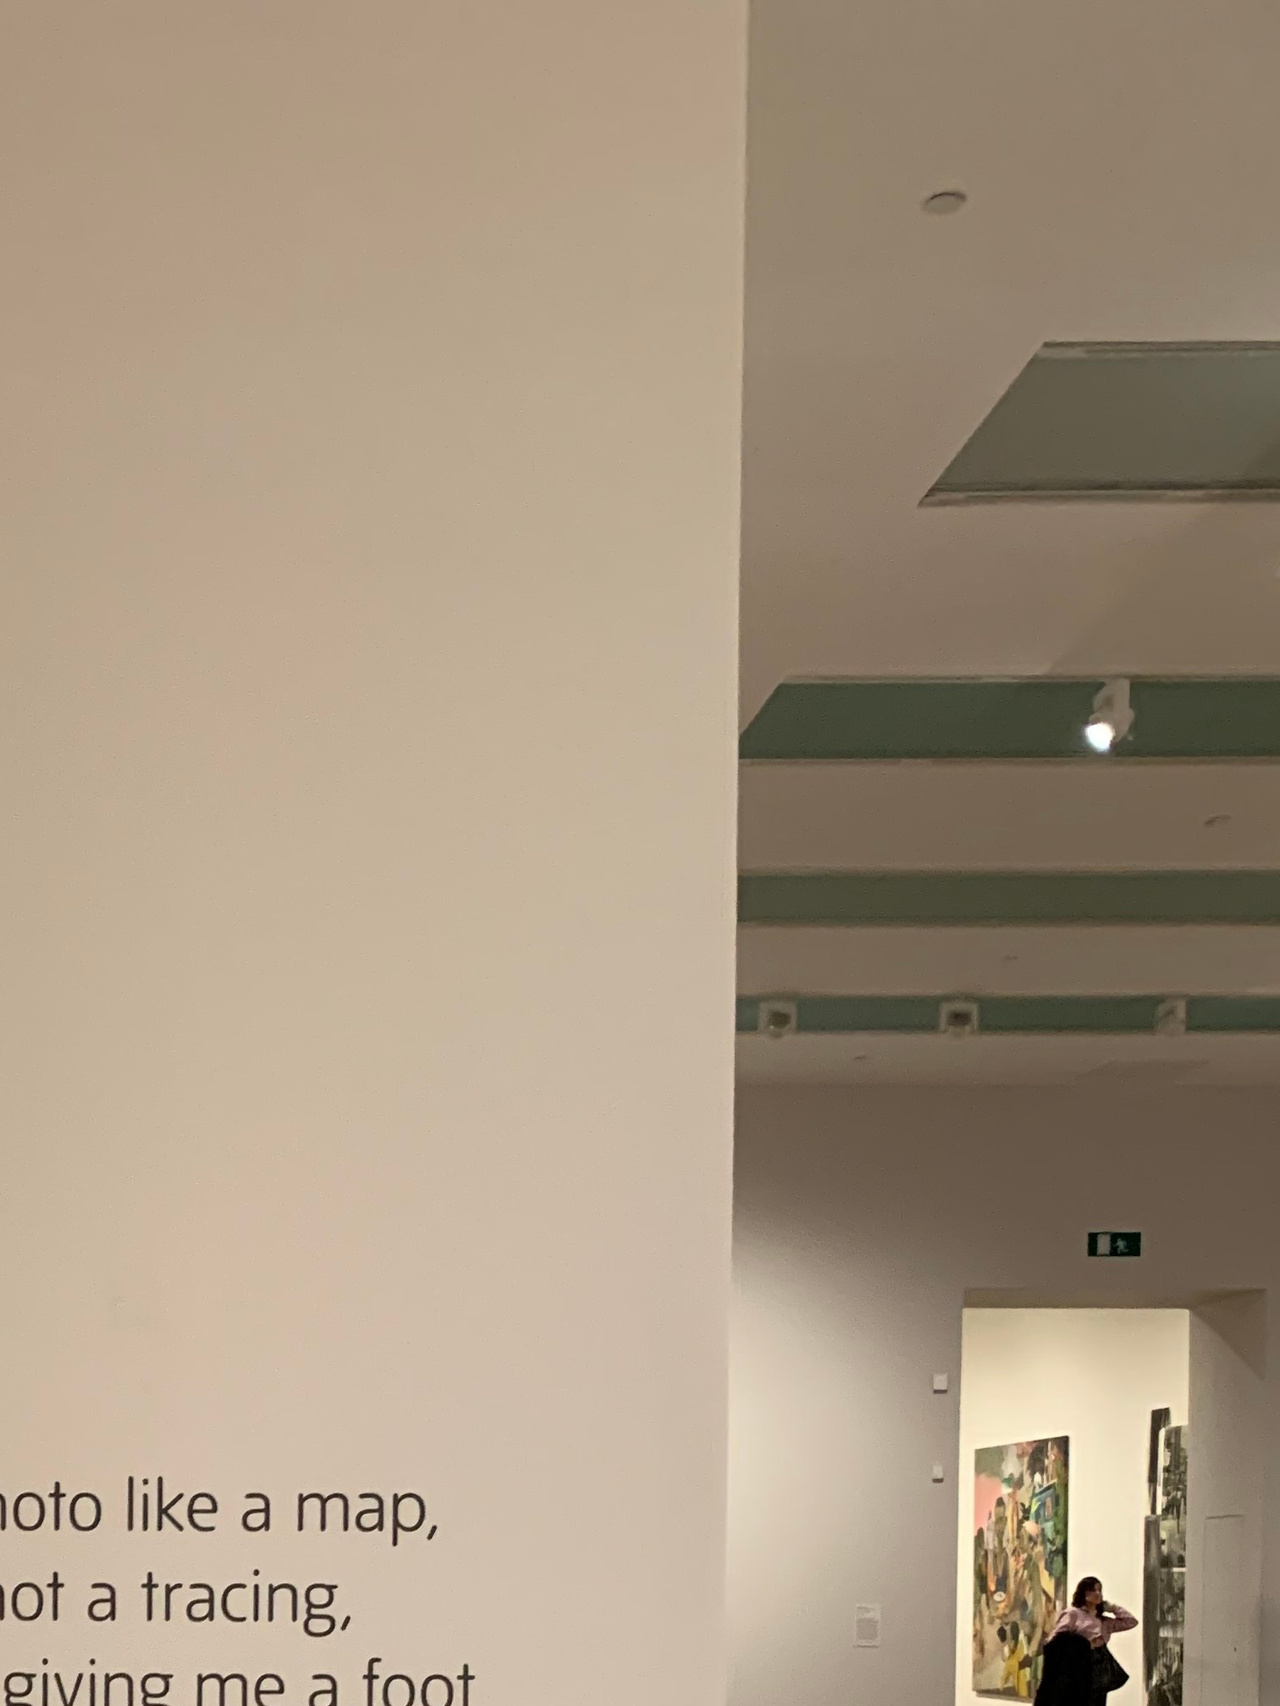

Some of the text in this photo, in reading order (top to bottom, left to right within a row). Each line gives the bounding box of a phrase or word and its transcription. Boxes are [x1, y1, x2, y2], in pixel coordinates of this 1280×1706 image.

[126, 1475, 219, 1533] like
[241, 1492, 271, 1533] a
[296, 1492, 438, 1548] map,
[87, 1582, 117, 1623] a
[140, 1568, 352, 1639] tracing,
